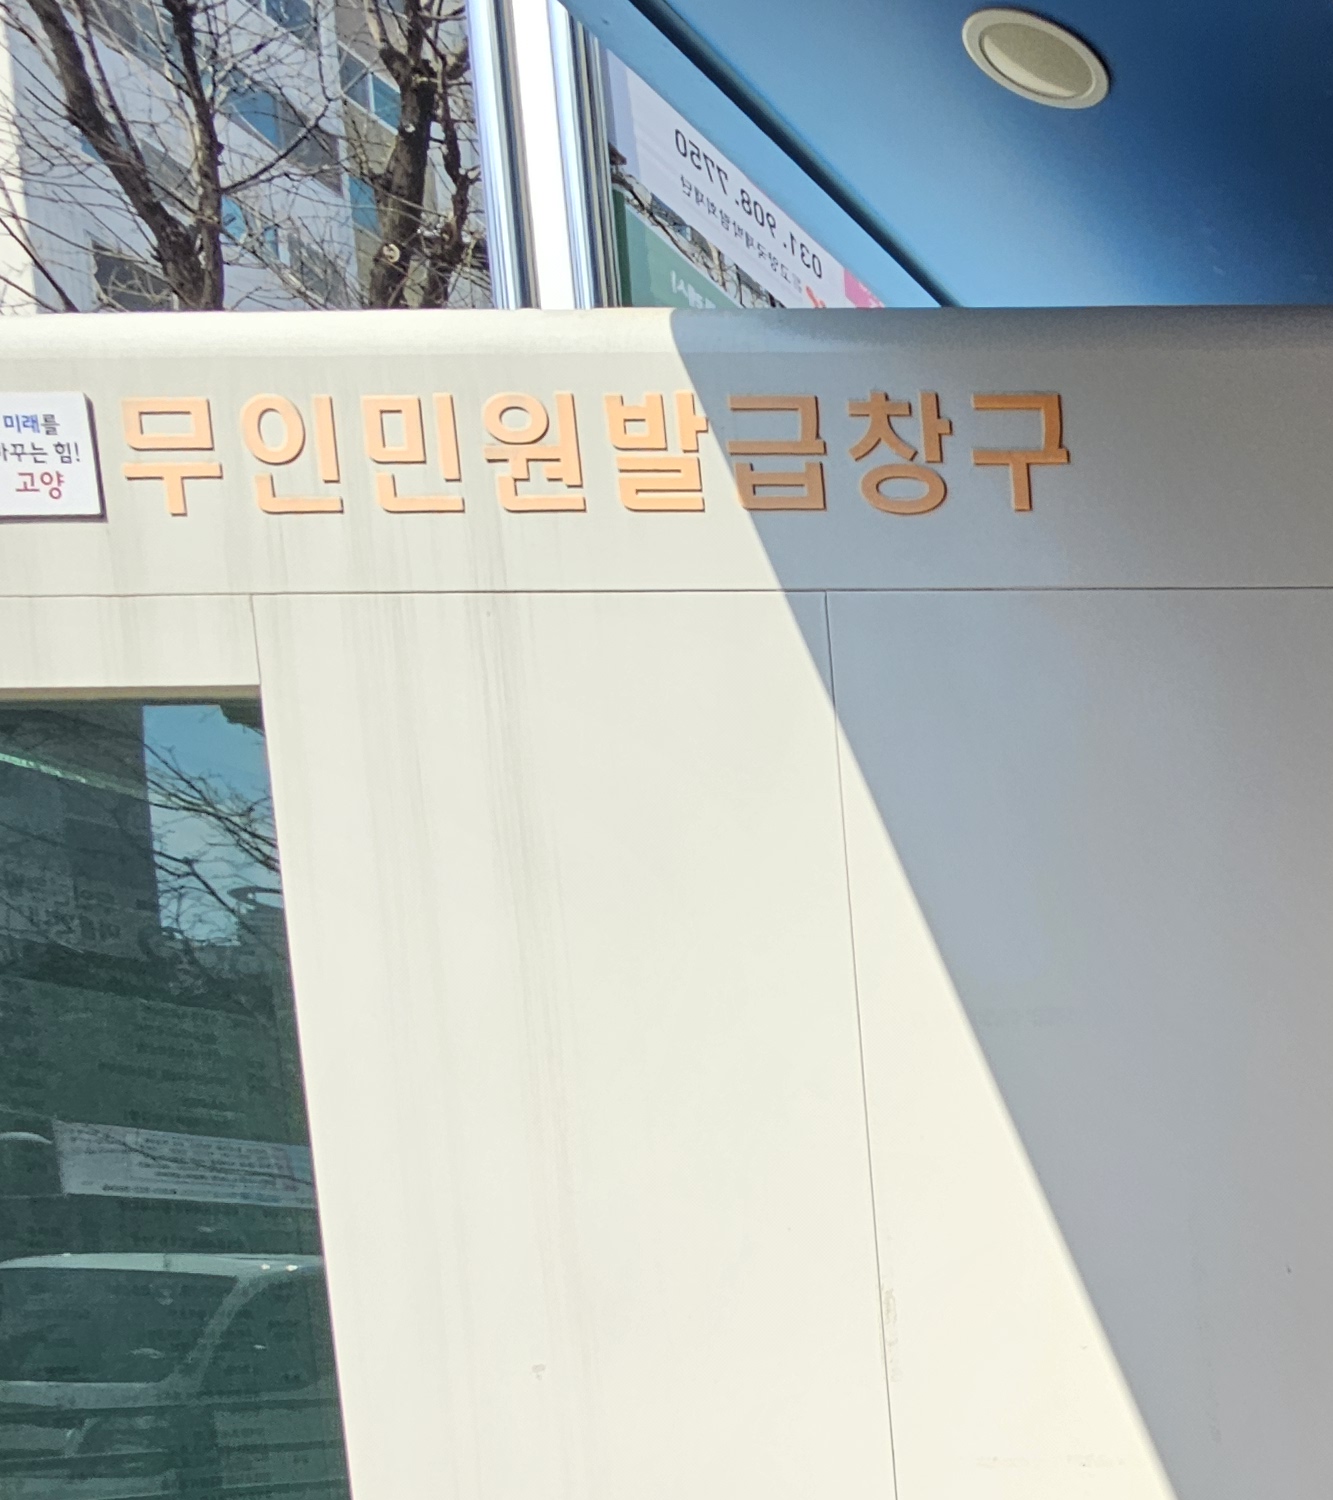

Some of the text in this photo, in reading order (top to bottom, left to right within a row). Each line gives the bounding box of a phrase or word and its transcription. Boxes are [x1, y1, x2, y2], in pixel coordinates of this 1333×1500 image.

[3, 413, 61, 436] 미래를
[53, 441, 82, 465] 힘!
[121, 390, 1070, 516] 무인민원발급창구
[15, 470, 66, 500] 고양
